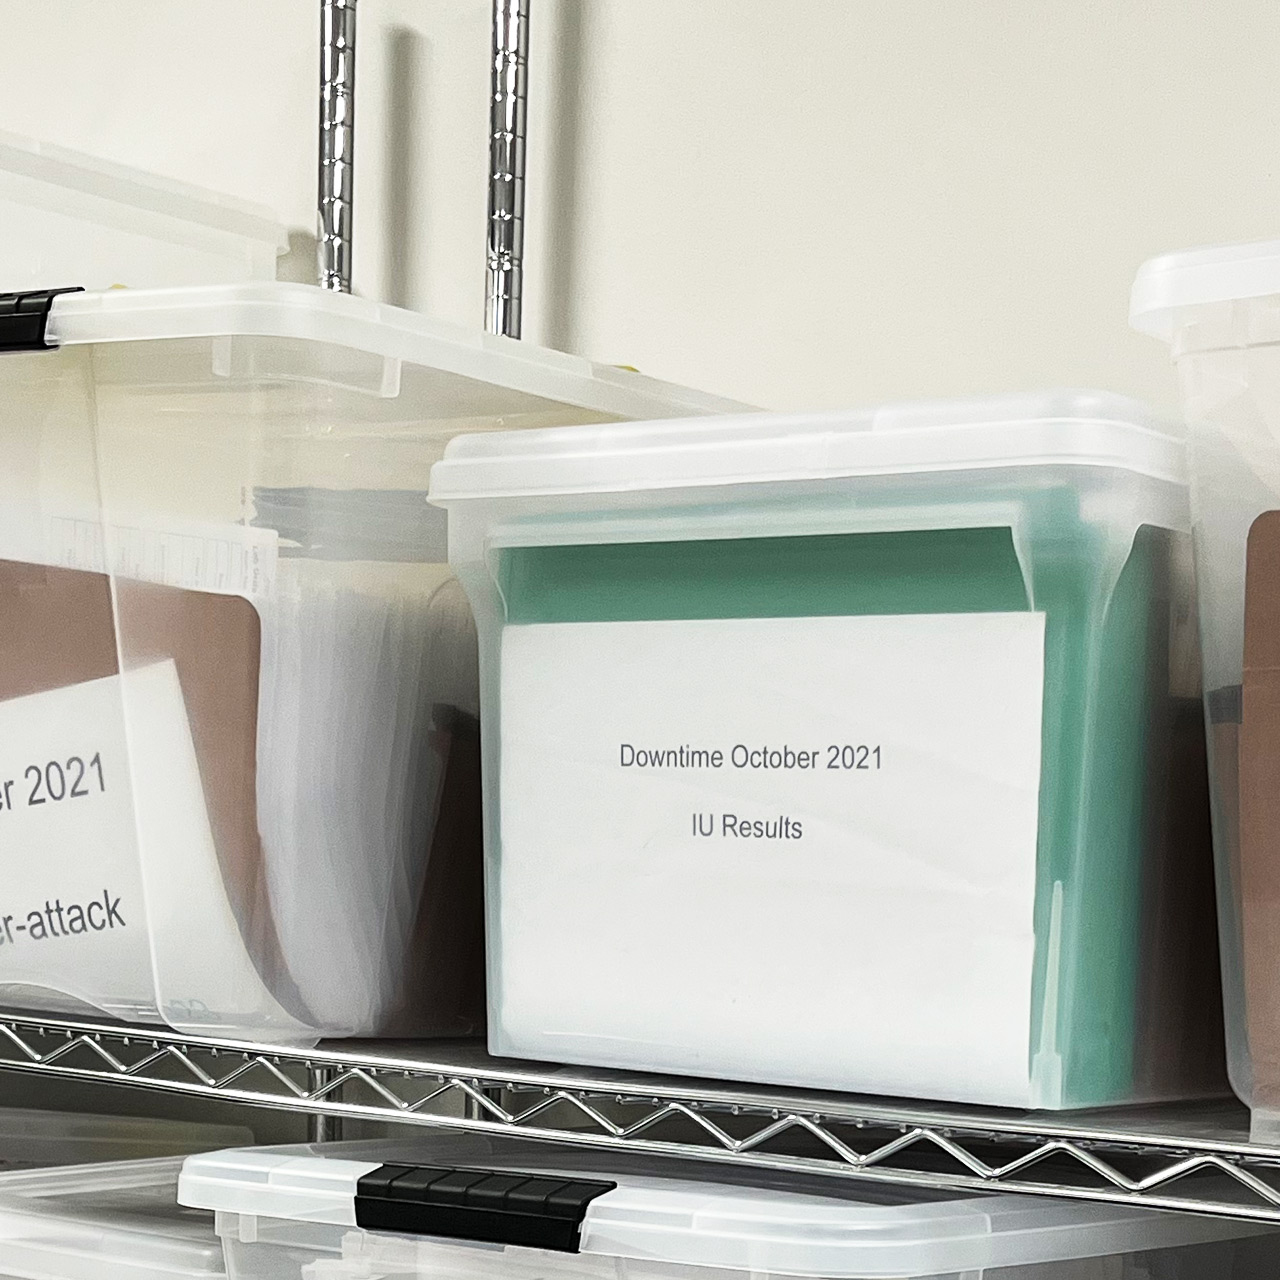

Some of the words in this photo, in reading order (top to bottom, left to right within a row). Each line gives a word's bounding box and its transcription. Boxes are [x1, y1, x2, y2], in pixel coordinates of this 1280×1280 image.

[620, 744, 723, 768] Downtime
[731, 744, 819, 769] October
[827, 745, 881, 769] 2021
[24, 752, 105, 806] 2021
[692, 813, 714, 837] IU
[722, 814, 802, 839] Results
